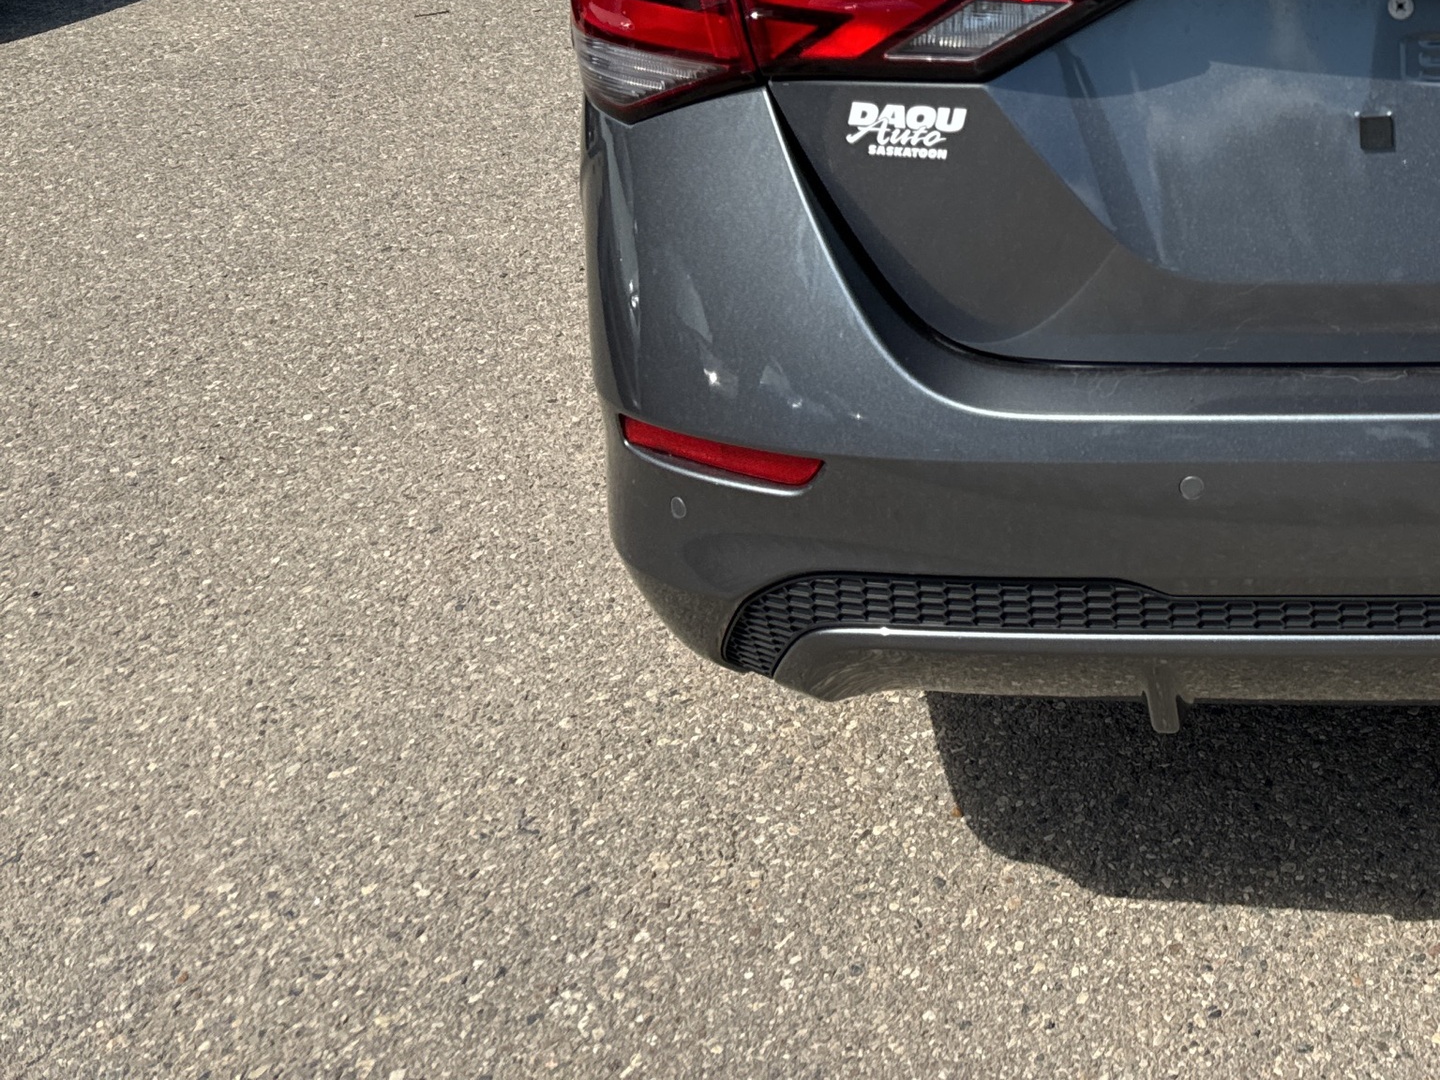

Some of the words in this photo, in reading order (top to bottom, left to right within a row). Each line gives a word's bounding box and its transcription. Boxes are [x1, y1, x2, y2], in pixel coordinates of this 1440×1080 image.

[848, 101, 967, 132] DAOU
[846, 117, 946, 146] Auto
[868, 144, 948, 160] SASKATOON
